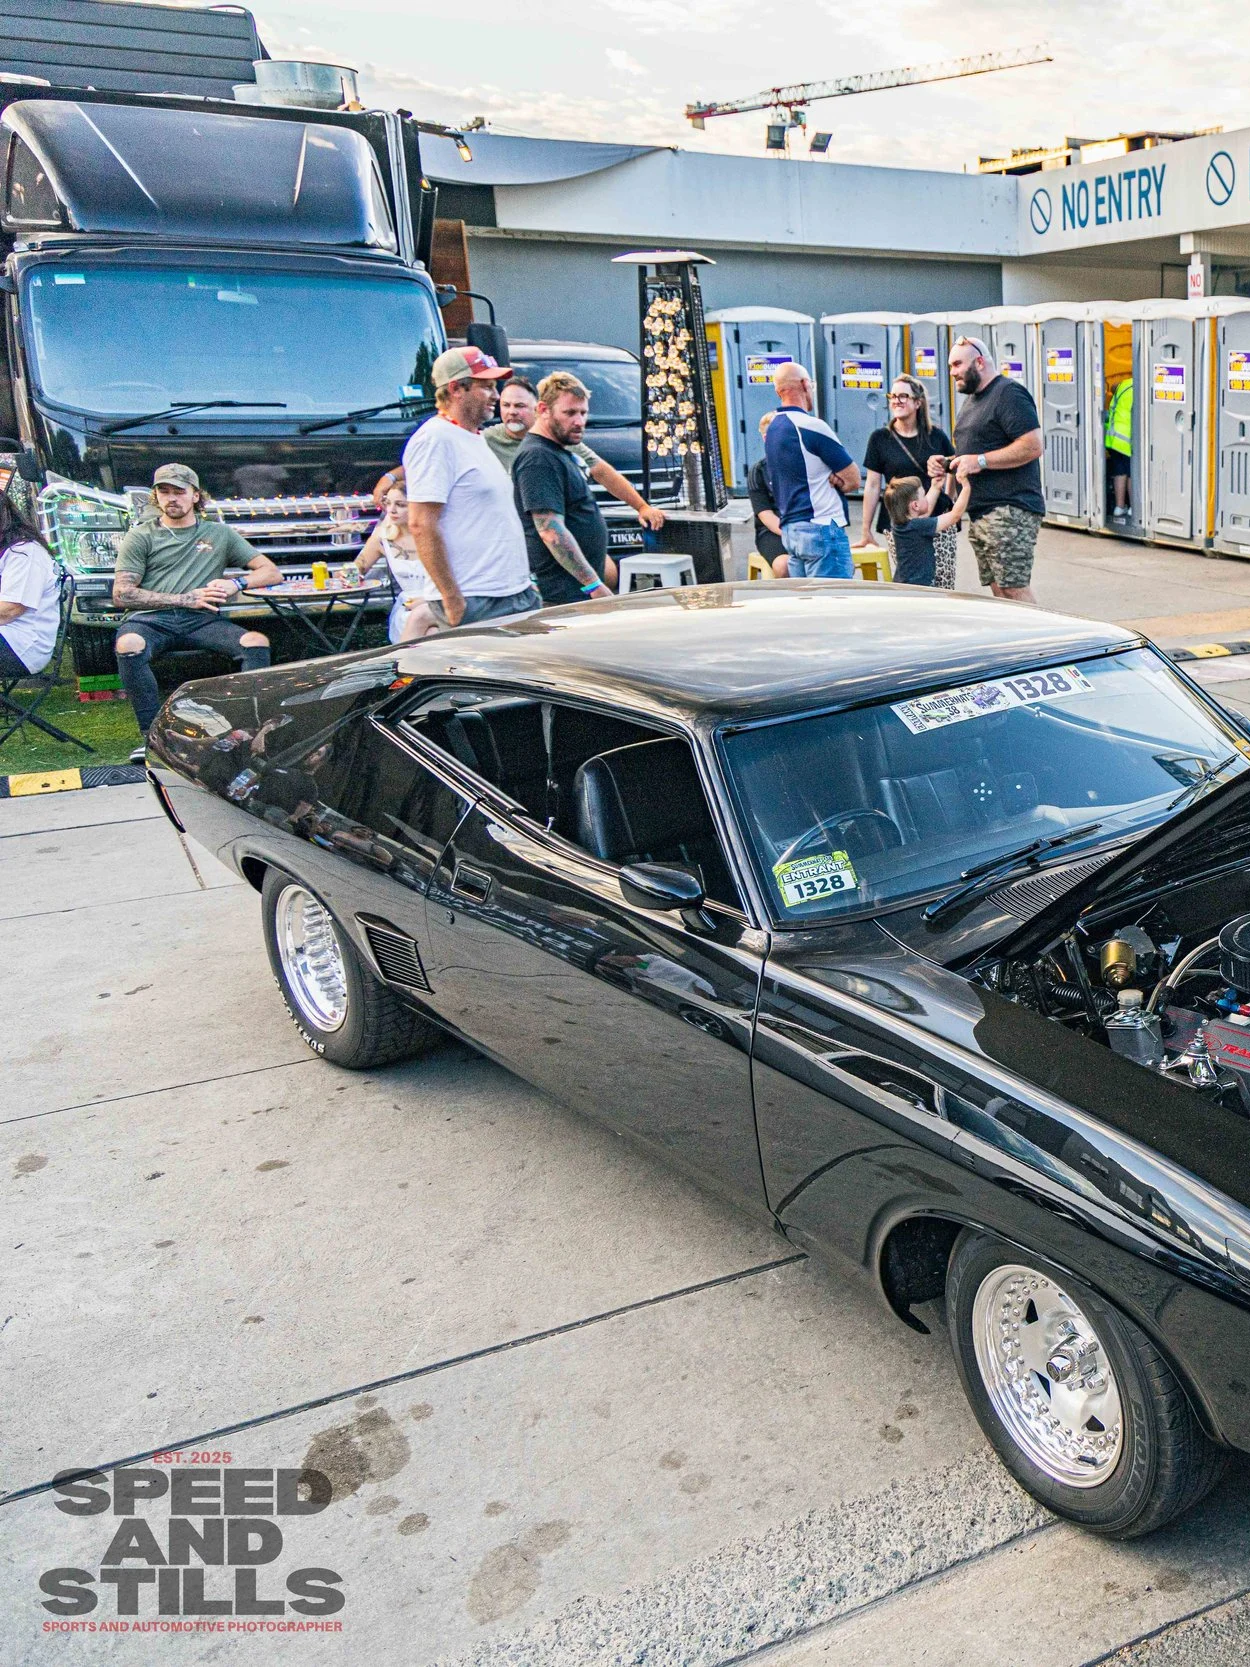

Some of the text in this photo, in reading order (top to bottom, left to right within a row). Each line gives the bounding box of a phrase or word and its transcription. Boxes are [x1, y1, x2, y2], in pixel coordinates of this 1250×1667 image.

[1062, 163, 1166, 231] NO ENTRY
[1190, 272, 1202, 288] NO
[611, 533, 643, 543] TIKKA
[1003, 672, 1073, 702] 1328
[945, 705, 961, 717] 38
[781, 860, 845, 883] ENTRANT
[793, 874, 846, 899] 1328
